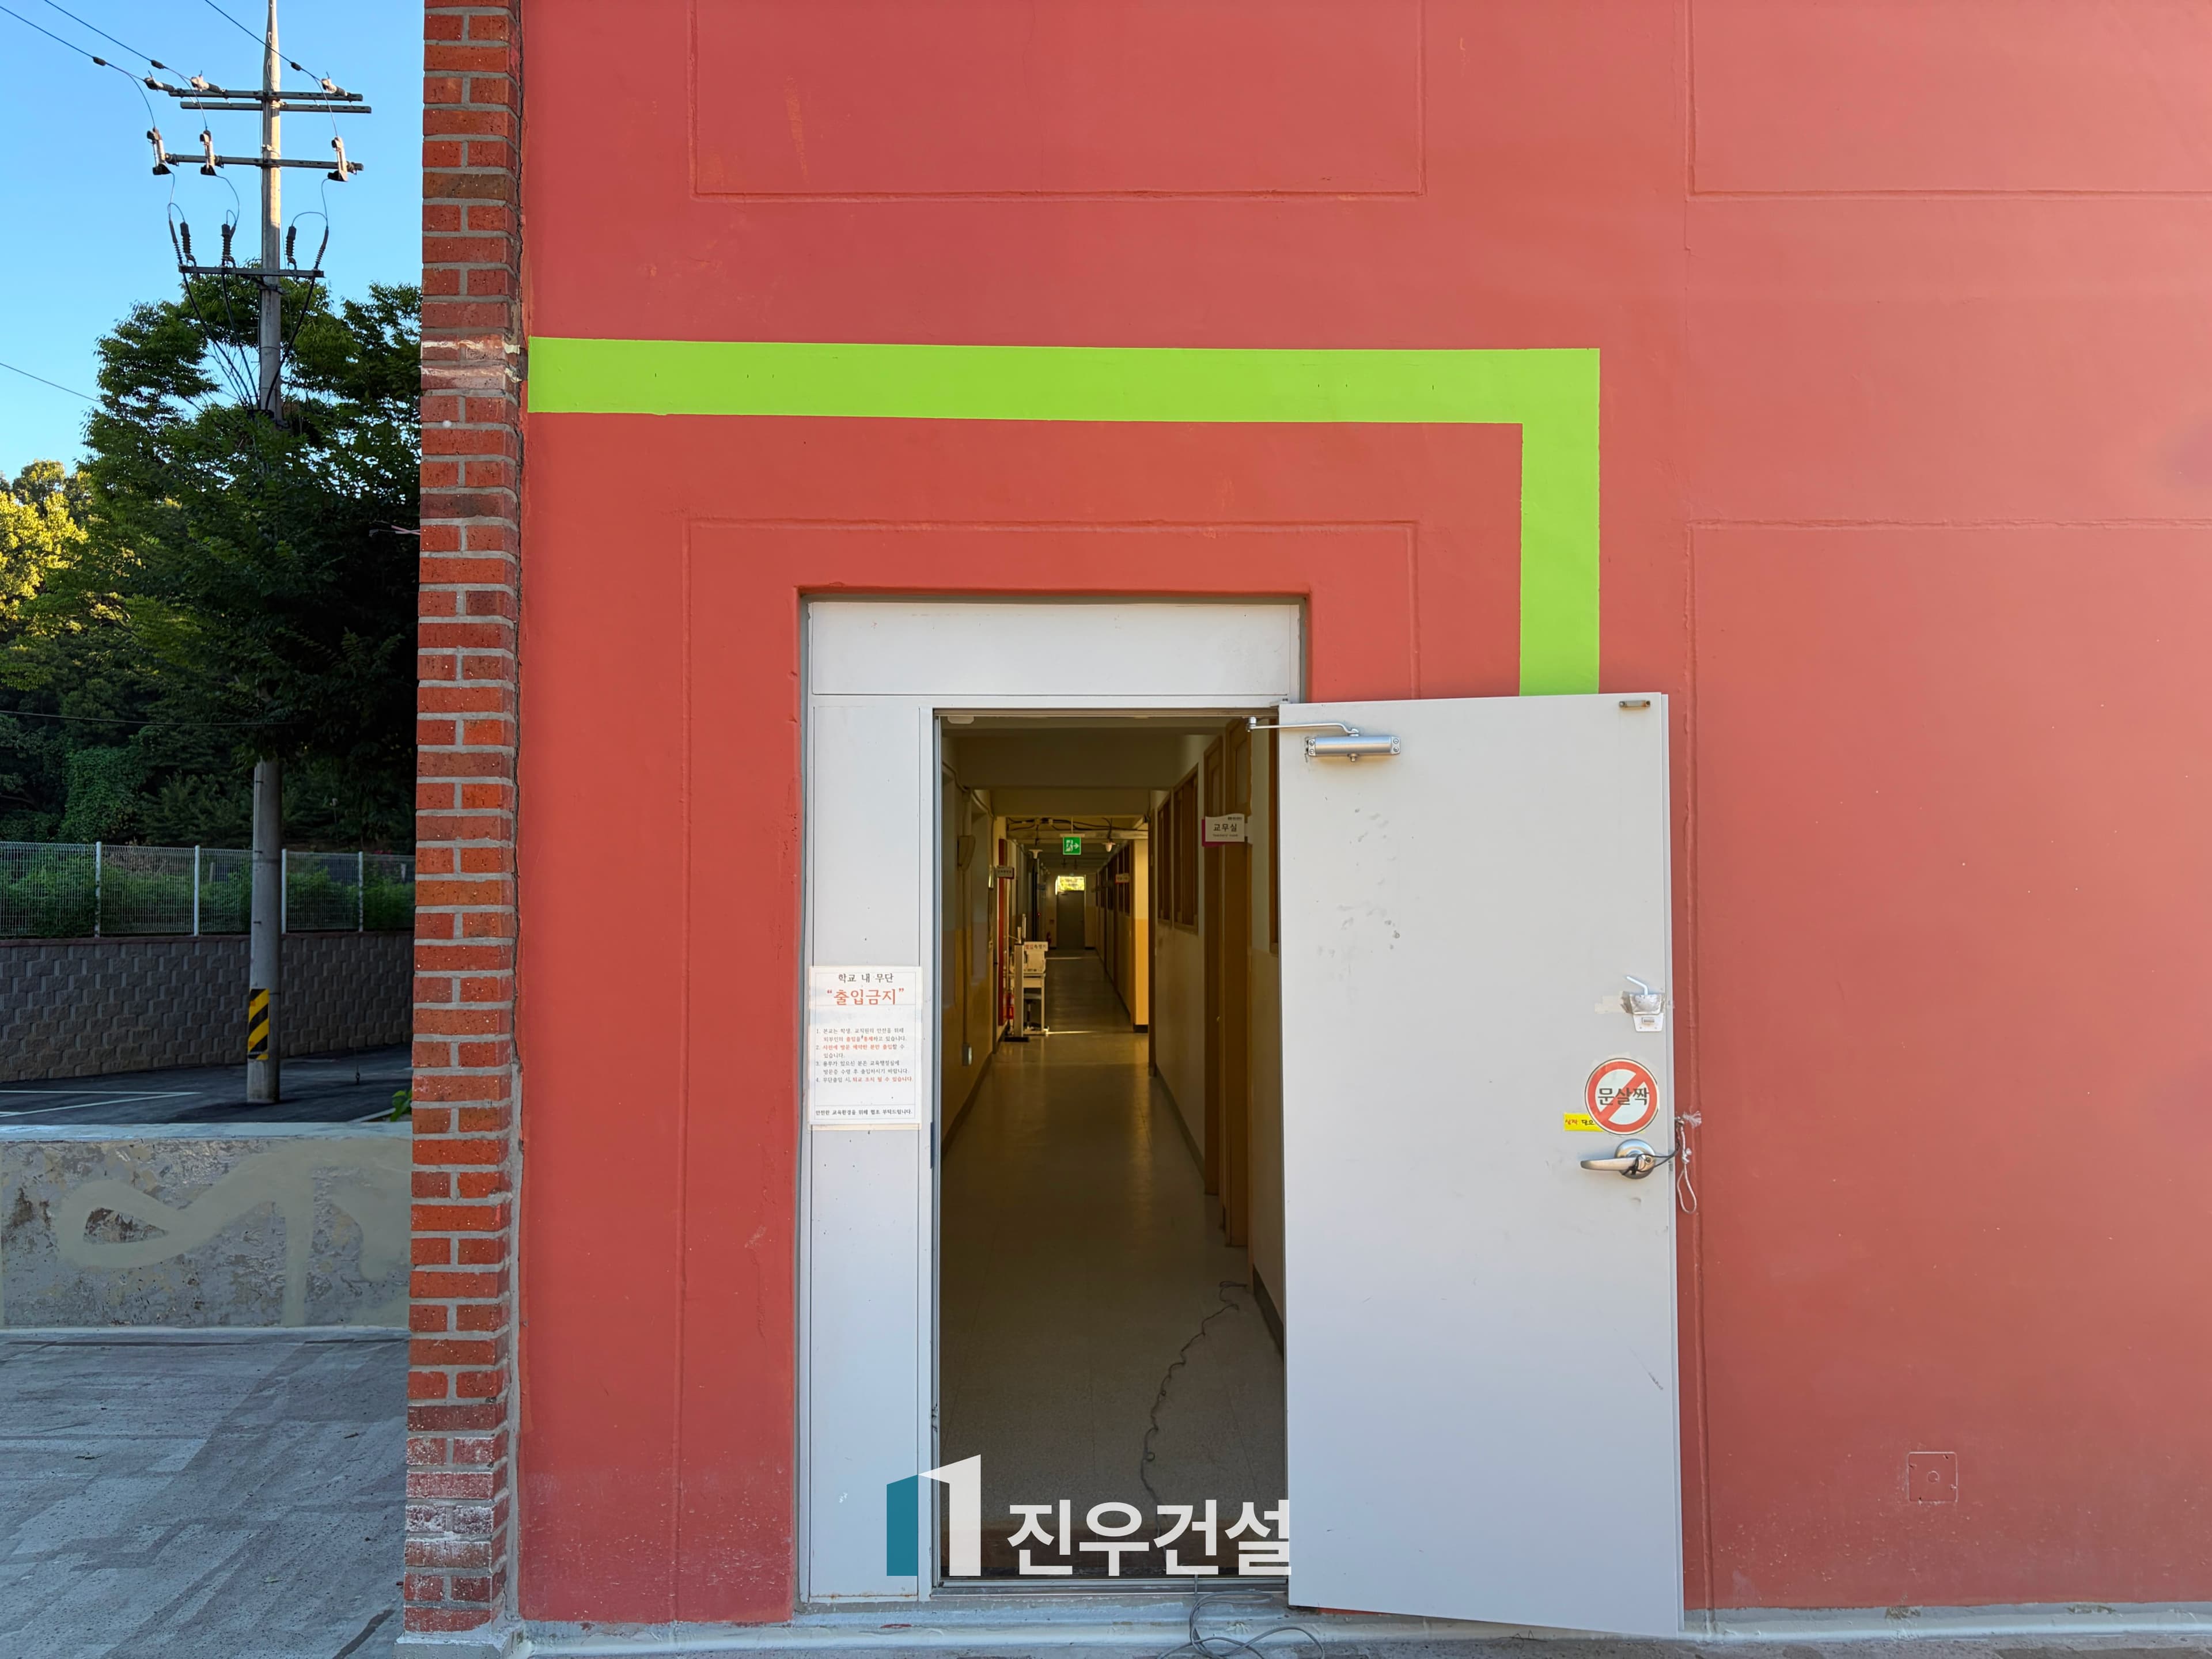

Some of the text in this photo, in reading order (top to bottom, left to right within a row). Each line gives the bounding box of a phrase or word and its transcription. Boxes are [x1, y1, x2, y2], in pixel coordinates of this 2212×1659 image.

[1213, 823, 1237, 832] 교무실
[839, 974, 893, 983] 학교 내 무단
[827, 988, 904, 1005] “출입금지”
[1597, 1087, 1650, 1106] 문살짝
